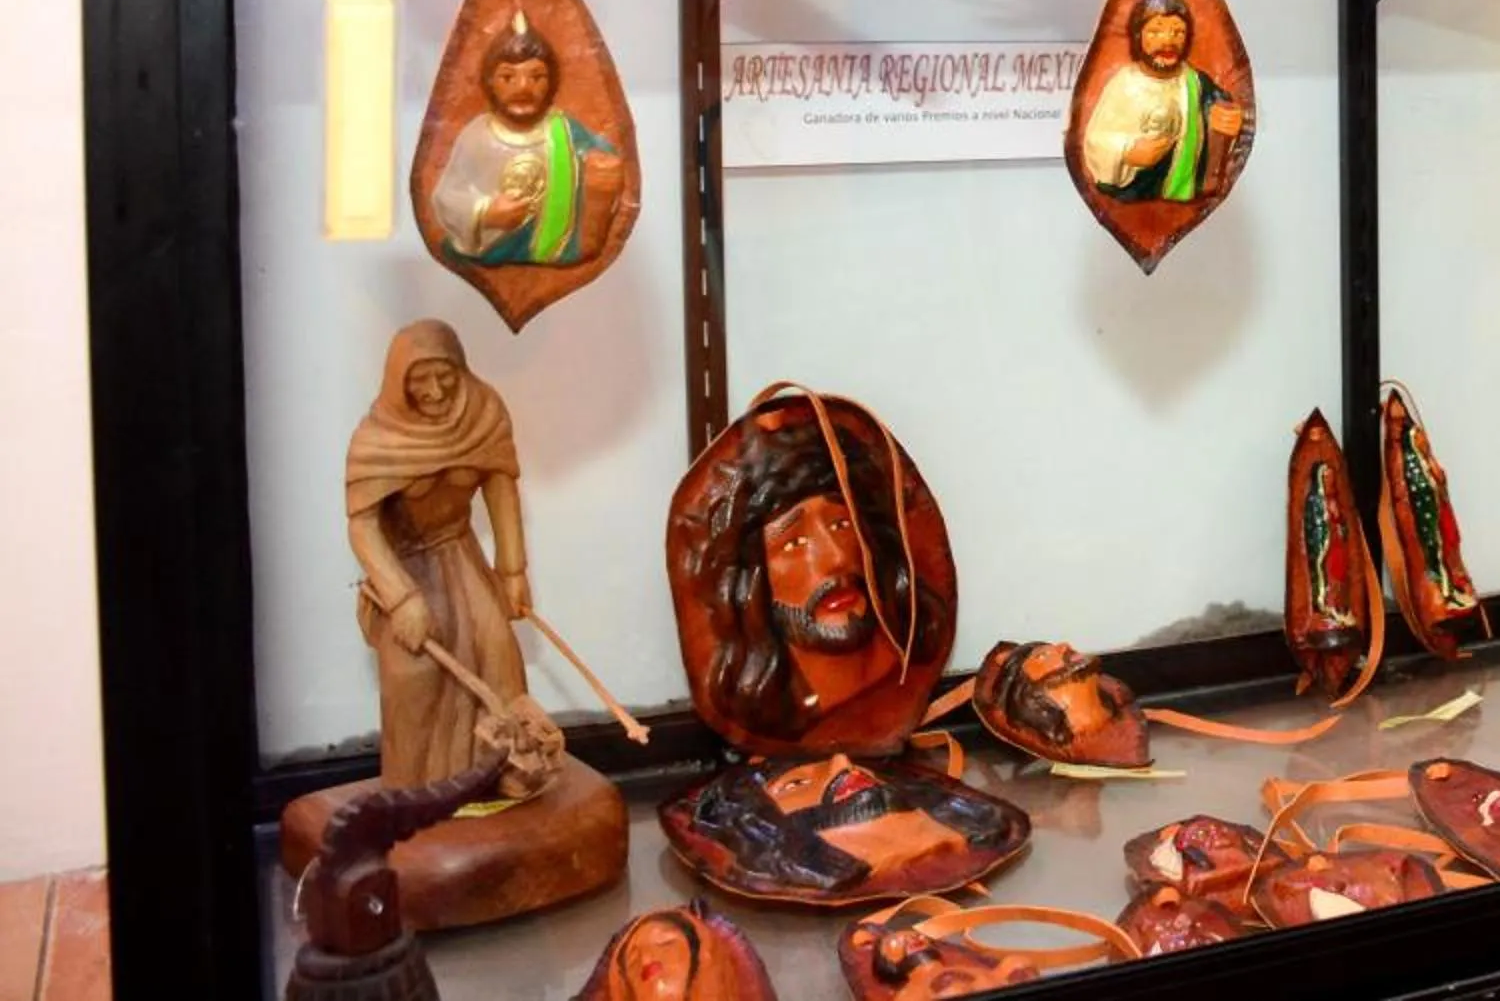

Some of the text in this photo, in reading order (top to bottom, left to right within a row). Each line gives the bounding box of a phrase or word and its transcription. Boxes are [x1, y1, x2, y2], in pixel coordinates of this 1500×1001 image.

[879, 53, 1006, 107] REGIONAL
[1011, 51, 1087, 93] MEXI
[803, 112, 862, 125] Ganadora
[864, 109, 880, 124] de
[922, 109, 969, 122] Premios
[1013, 108, 1062, 120] Nacional
